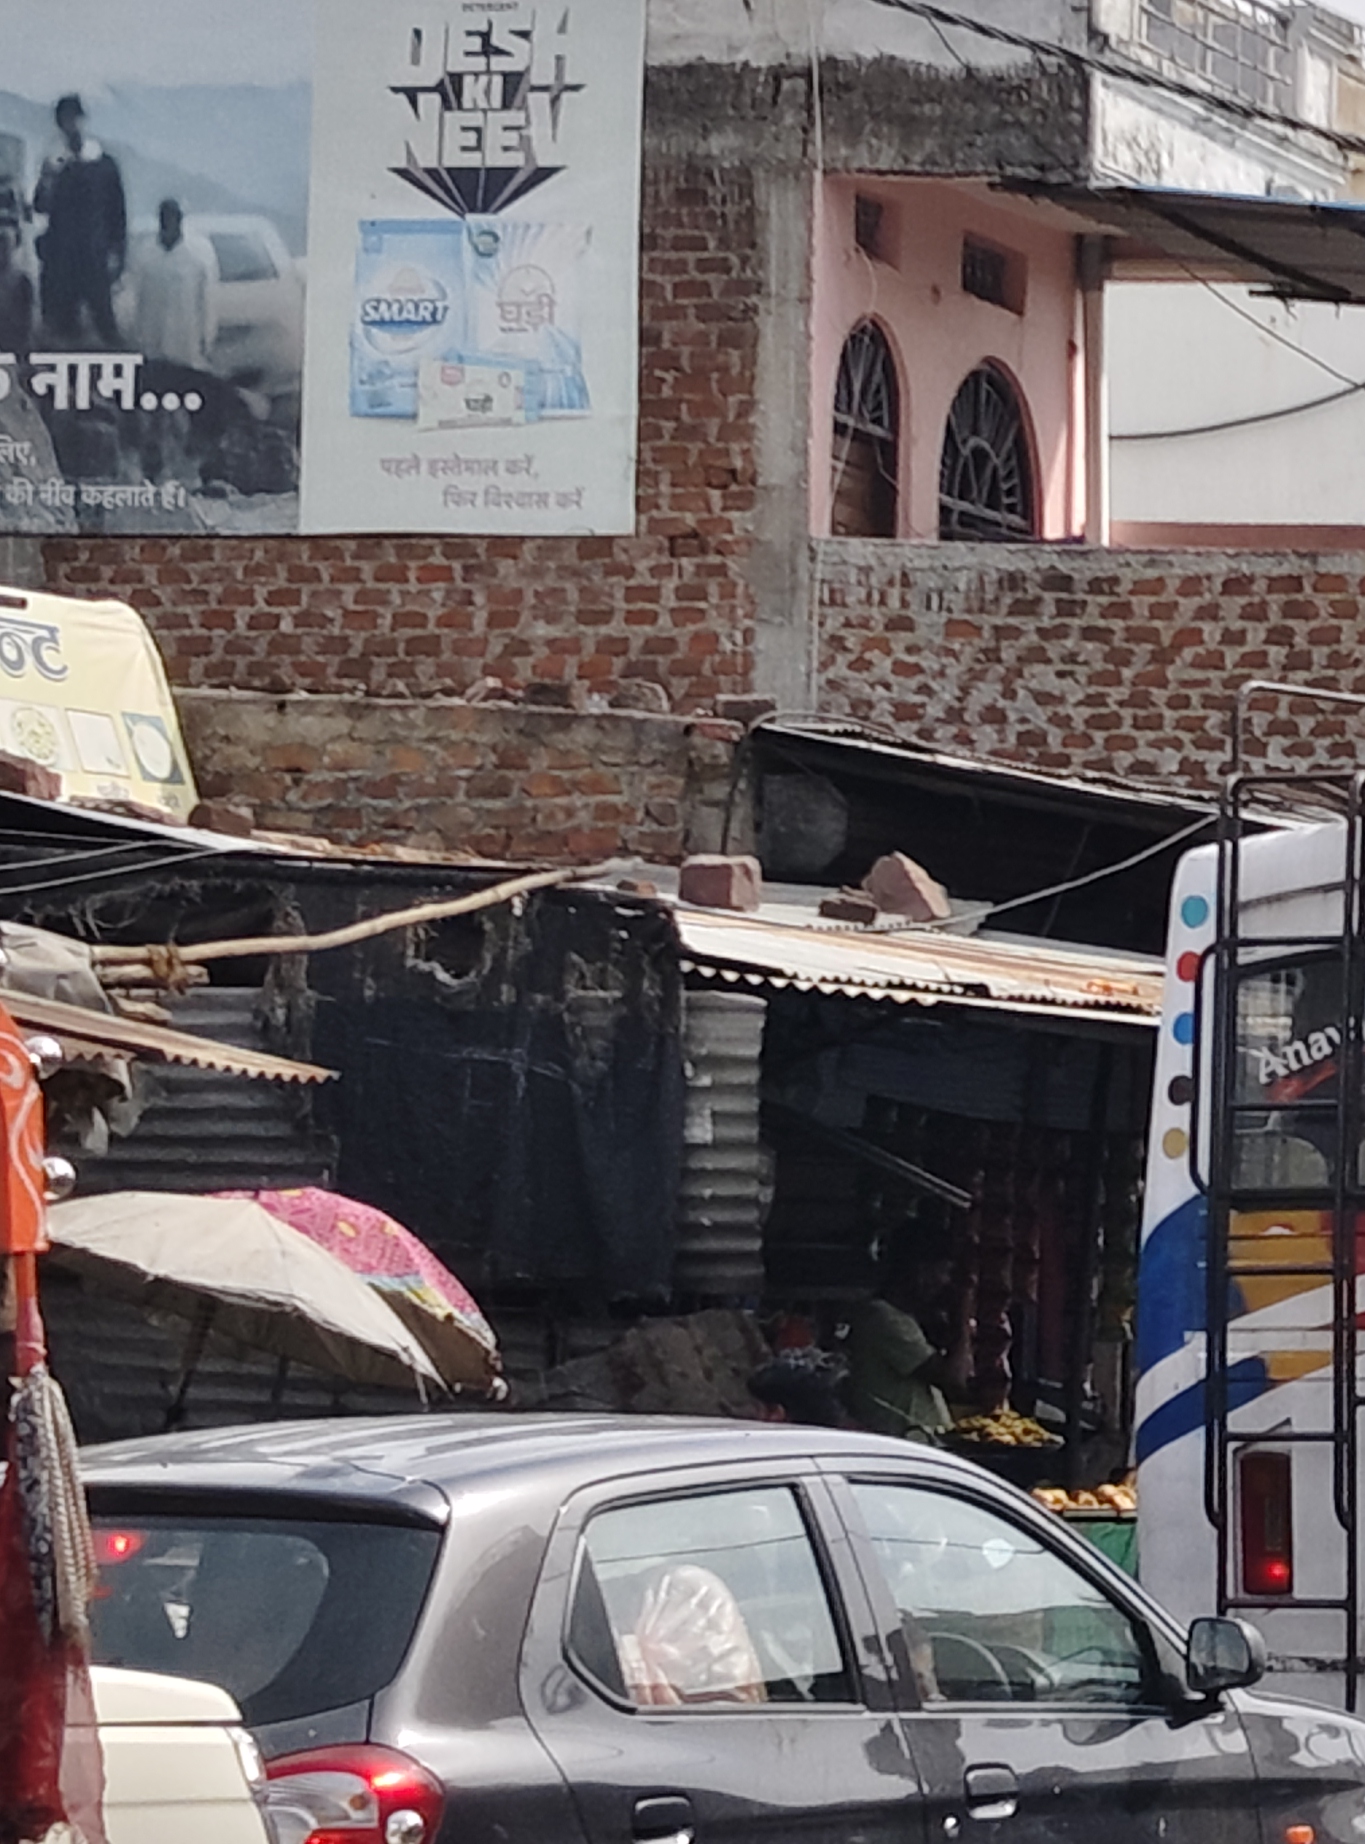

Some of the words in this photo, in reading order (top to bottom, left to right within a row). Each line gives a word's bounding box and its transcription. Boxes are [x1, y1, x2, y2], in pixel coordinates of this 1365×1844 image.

[461, 74, 504, 109] KI
[390, 90, 578, 168] NEEV
[361, 300, 449, 324] SMART
